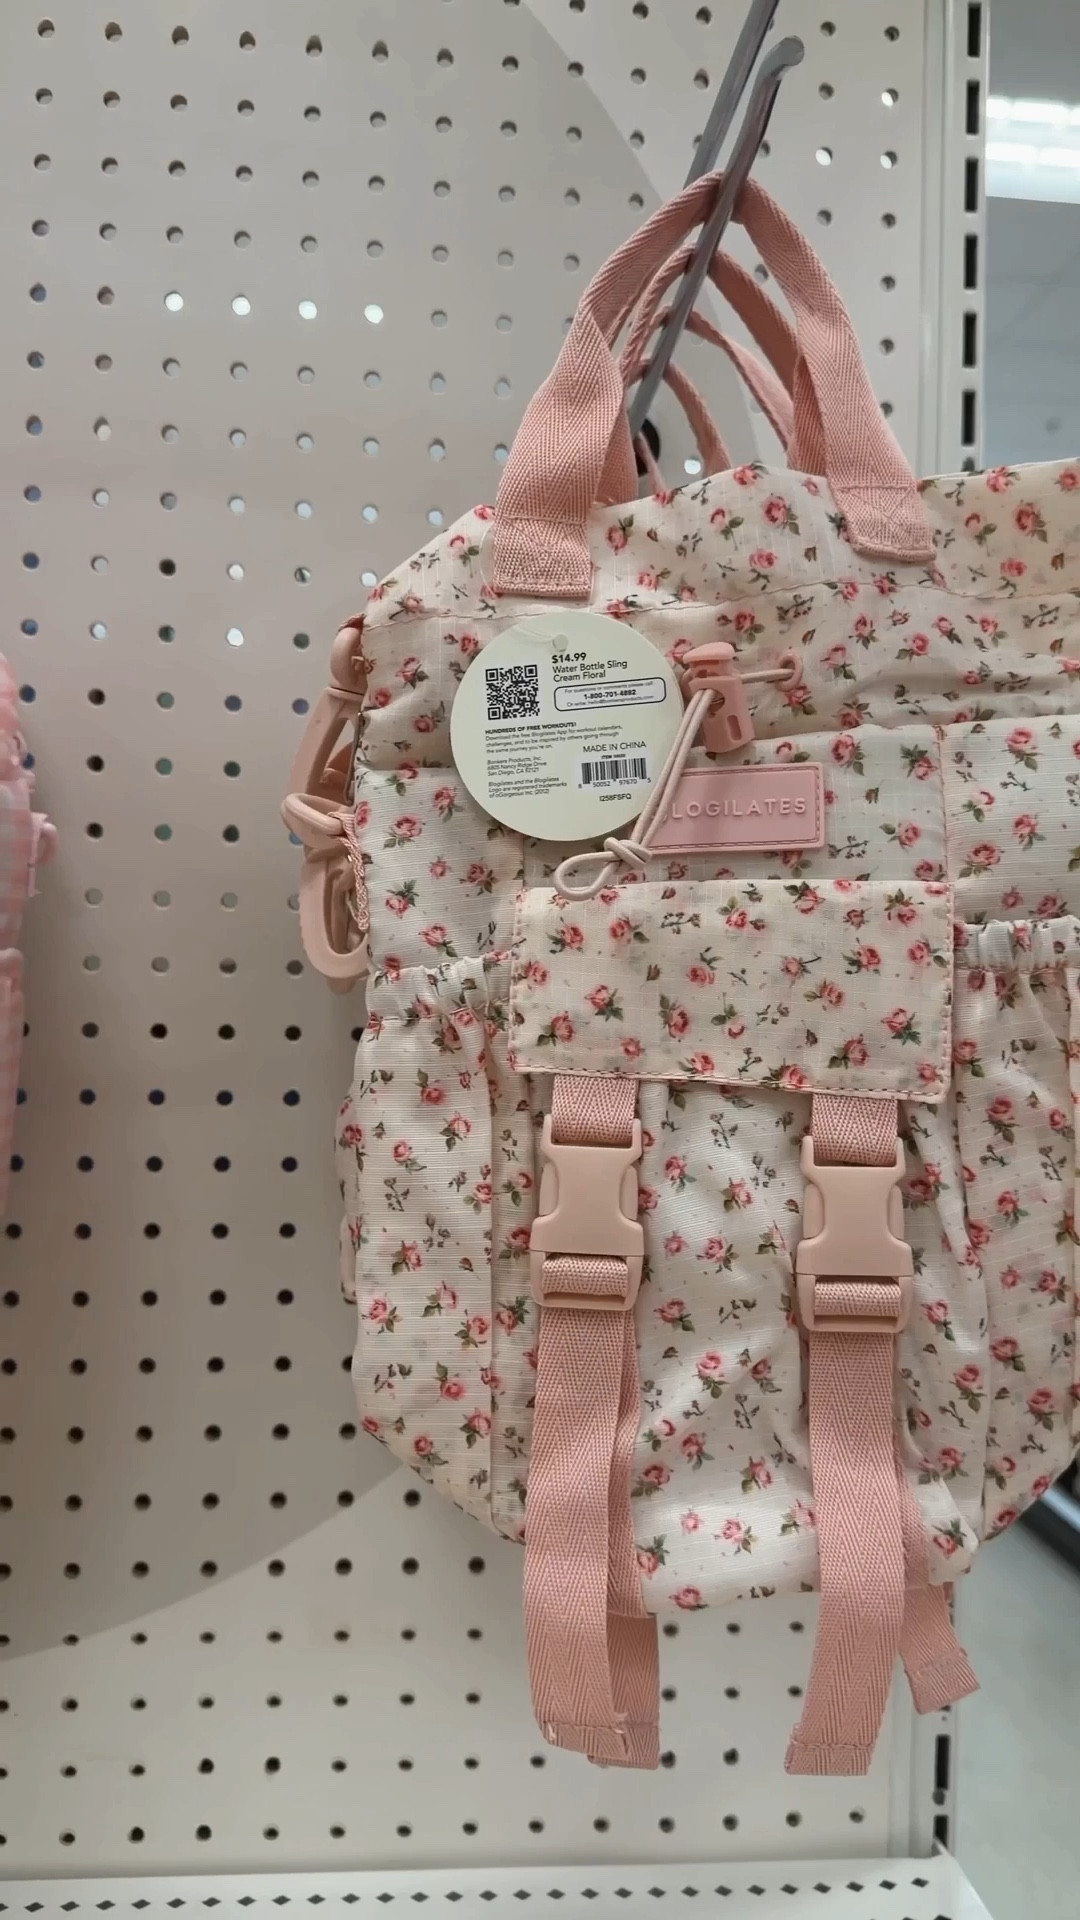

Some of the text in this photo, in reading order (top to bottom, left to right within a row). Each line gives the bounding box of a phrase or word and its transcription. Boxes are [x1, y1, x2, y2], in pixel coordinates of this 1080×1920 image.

[552, 652, 587, 664] $14.99
[552, 660, 628, 674] Water Bottle Sling
[553, 670, 606, 682] Cream Floral
[542, 721, 577, 729] WORKOUTS!
[582, 741, 647, 753] MADE IN CHINA
[592, 780, 611, 788] 50052
[662, 797, 807, 823] LOGILATES
